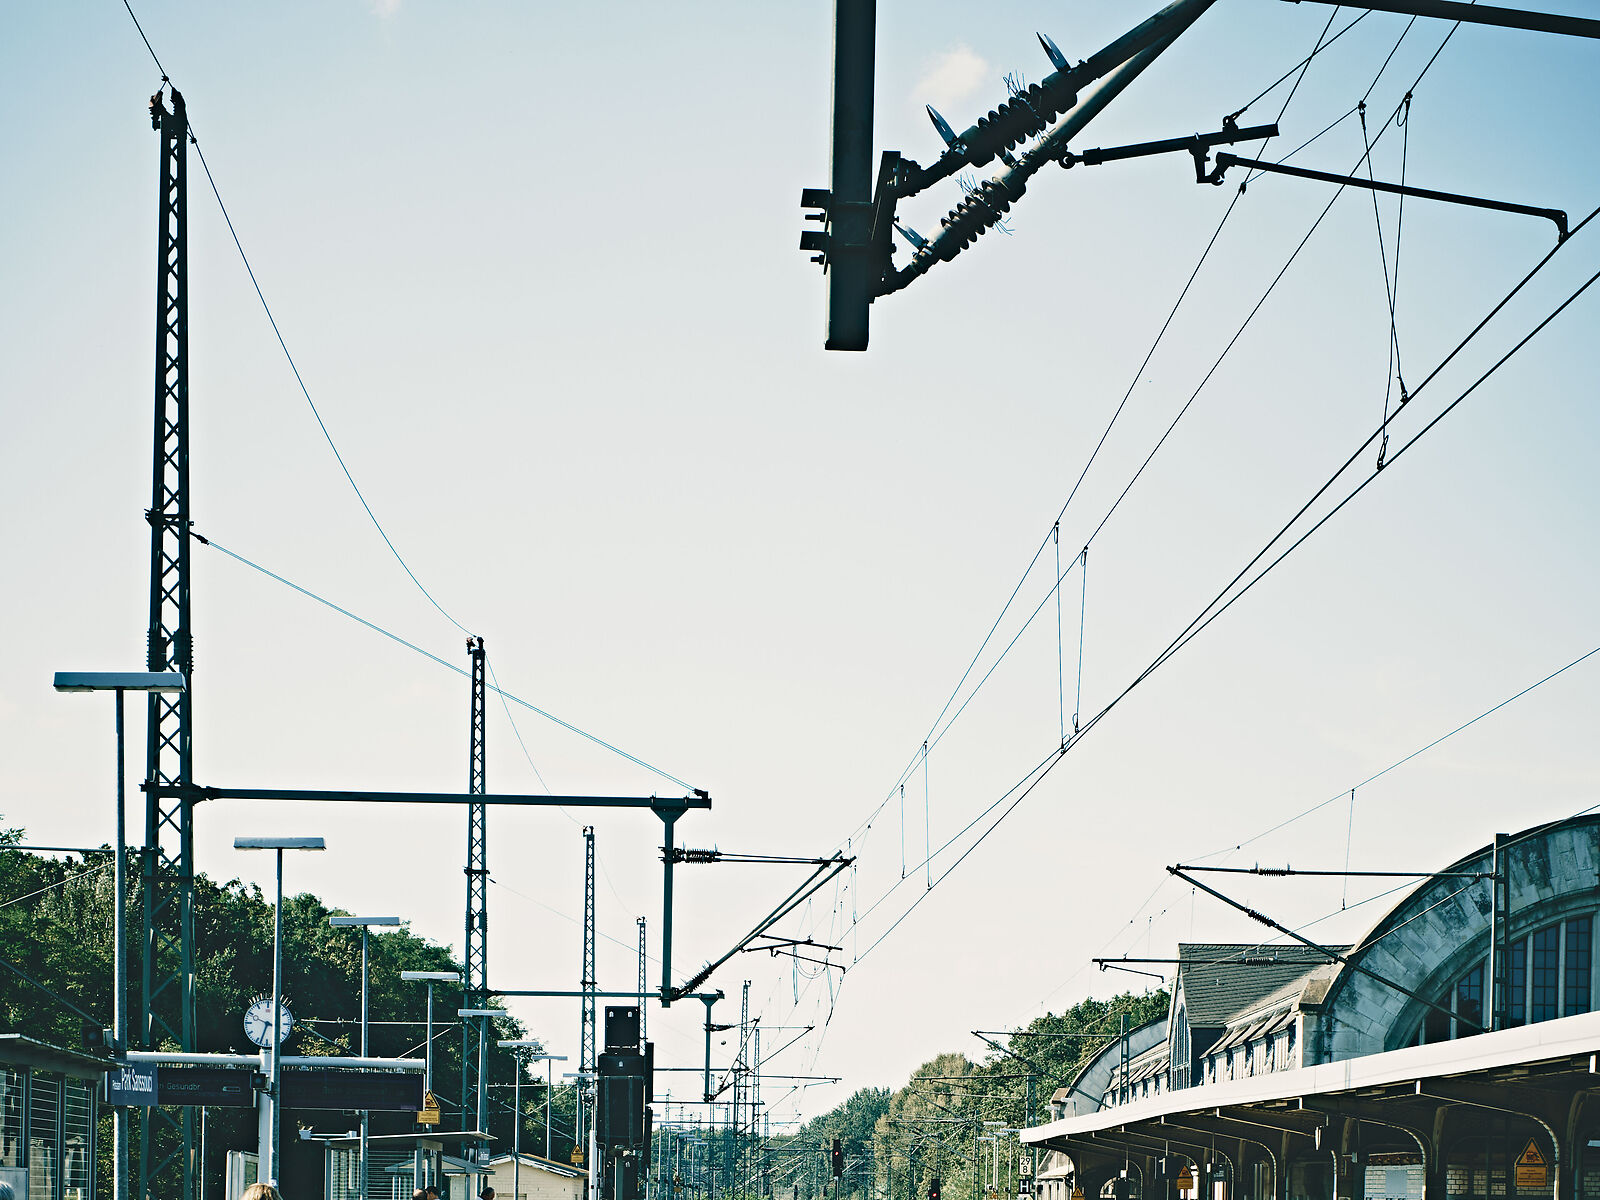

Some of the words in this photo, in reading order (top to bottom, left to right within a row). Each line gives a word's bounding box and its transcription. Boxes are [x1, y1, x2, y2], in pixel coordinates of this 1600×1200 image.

[121, 1067, 131, 1091] Park
[1020, 1158, 1031, 1166] 29
[1022, 1166, 1028, 1174] 8
[1020, 1180, 1030, 1193] H
